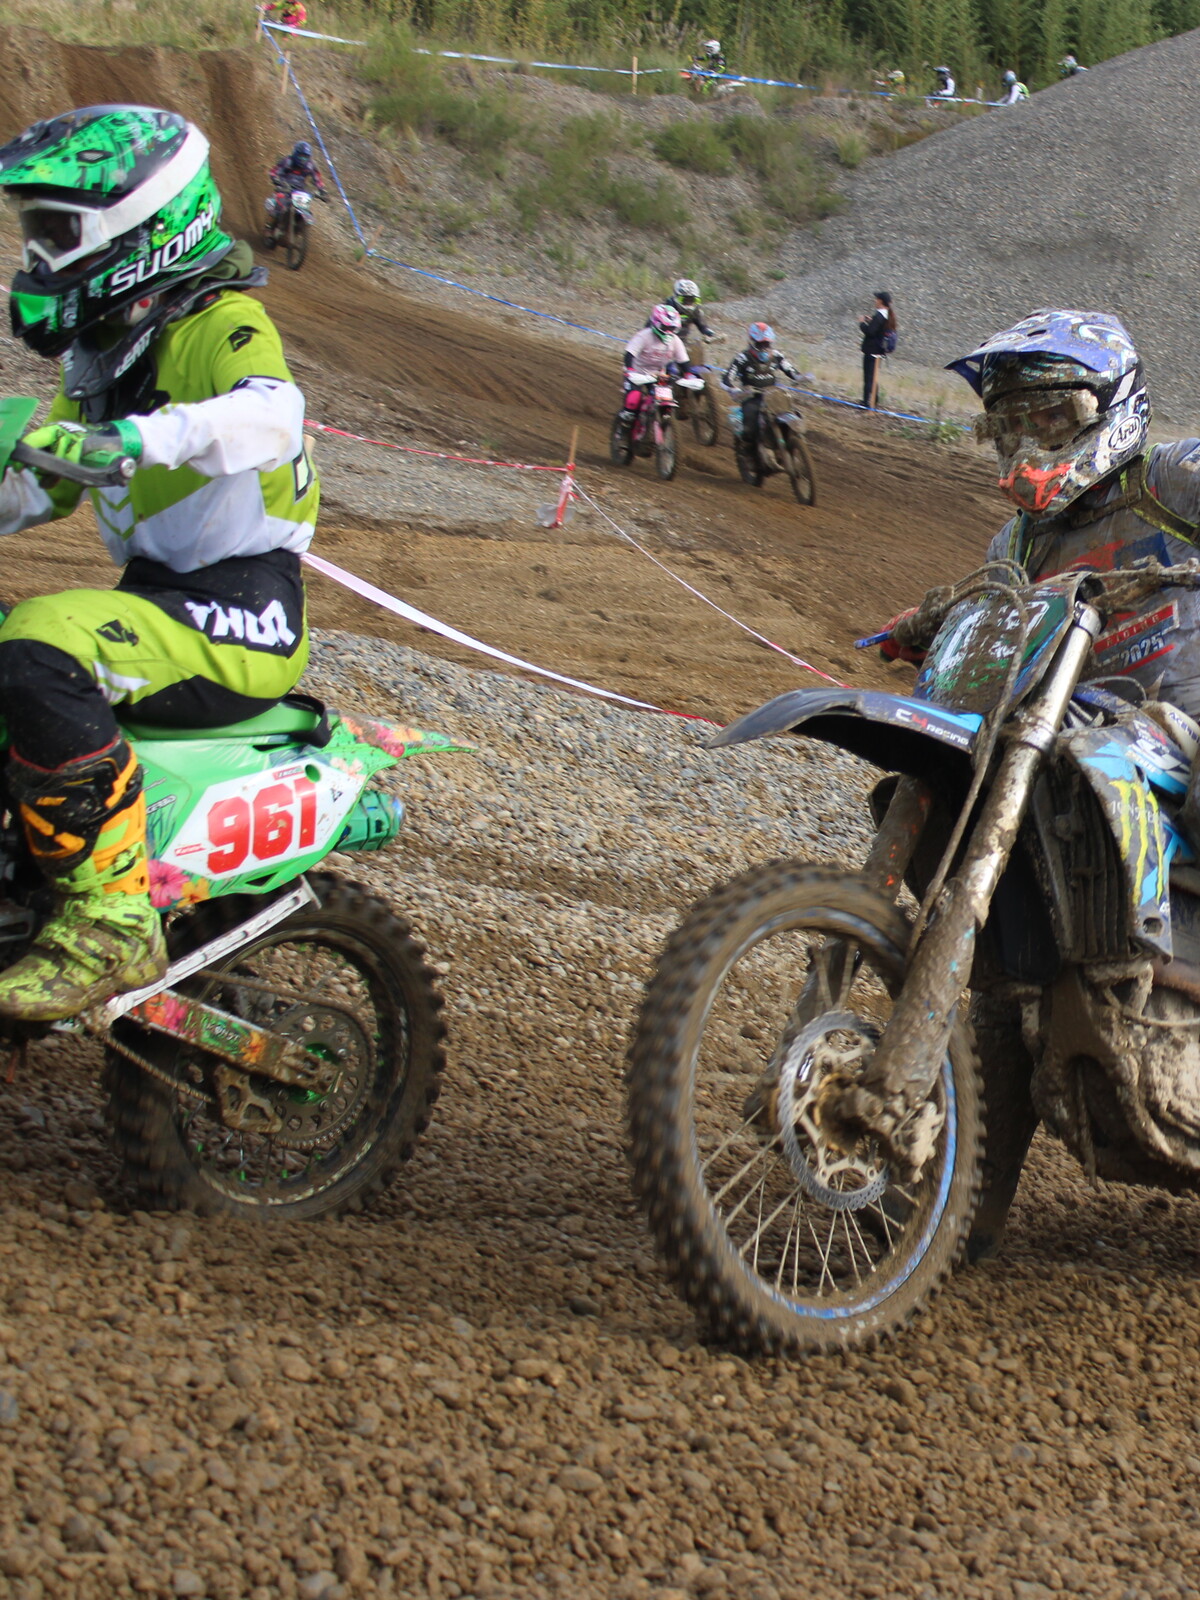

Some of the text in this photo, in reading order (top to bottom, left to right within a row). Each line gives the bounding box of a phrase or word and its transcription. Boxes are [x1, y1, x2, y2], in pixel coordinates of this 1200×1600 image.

[110, 203, 214, 297] SUOMY
[1112, 417, 1138, 448] Arai
[184, 600, 296, 646] THOR
[1119, 631, 1165, 668] 2025
[1168, 710, 1200, 744] ACERBI
[207, 776, 316, 875] 961
